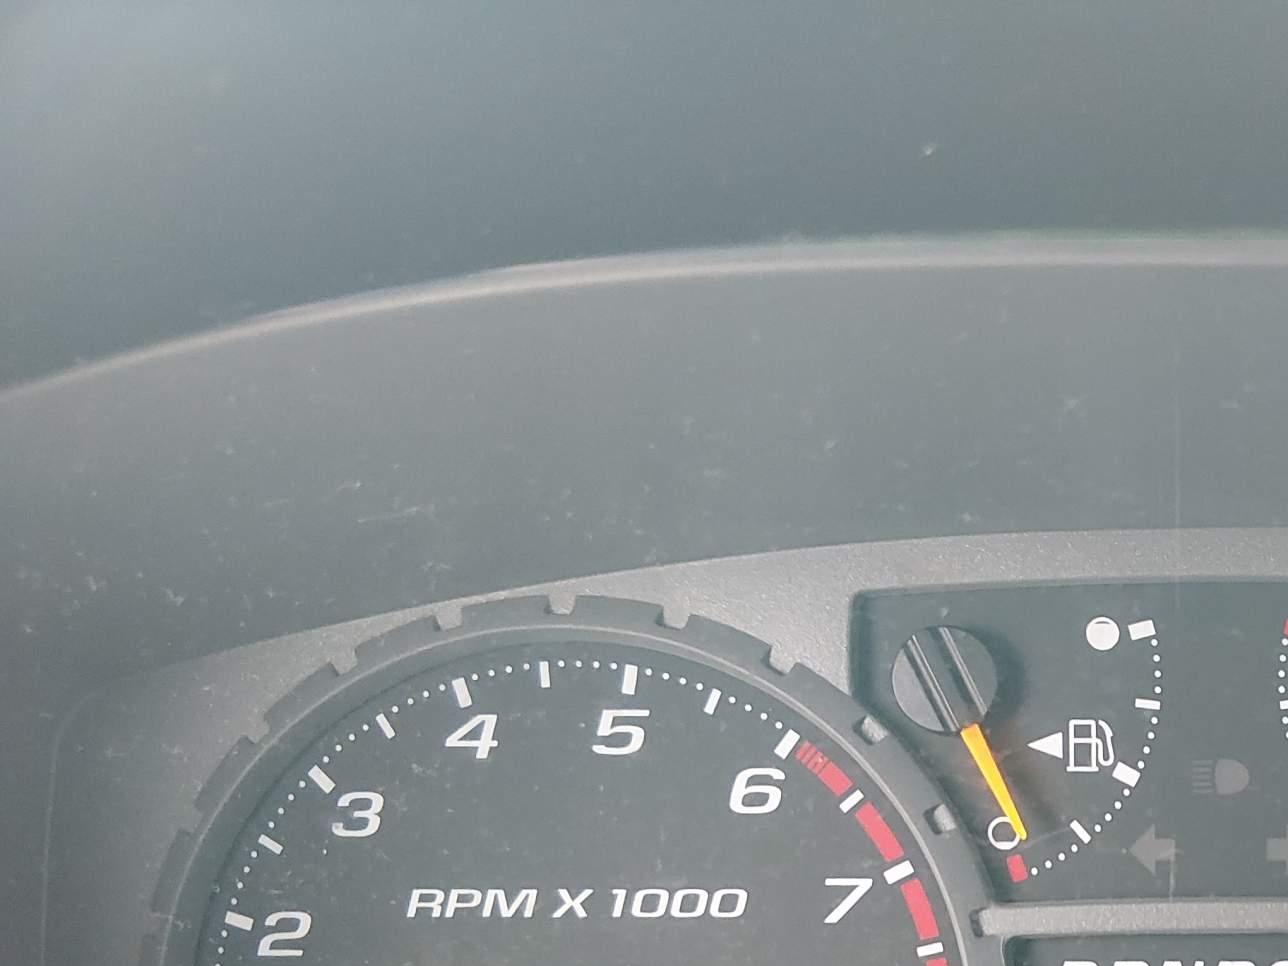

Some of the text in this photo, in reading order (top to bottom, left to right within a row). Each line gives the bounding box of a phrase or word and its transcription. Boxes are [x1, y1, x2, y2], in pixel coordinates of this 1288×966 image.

[445, 714, 498, 759] 4
[591, 709, 650, 755] 5
[729, 767, 786, 814] 6
[331, 791, 384, 837] 3
[406, 888, 748, 918] RPM X 1000
[824, 878, 873, 924] 7
[257, 911, 312, 957] 2
